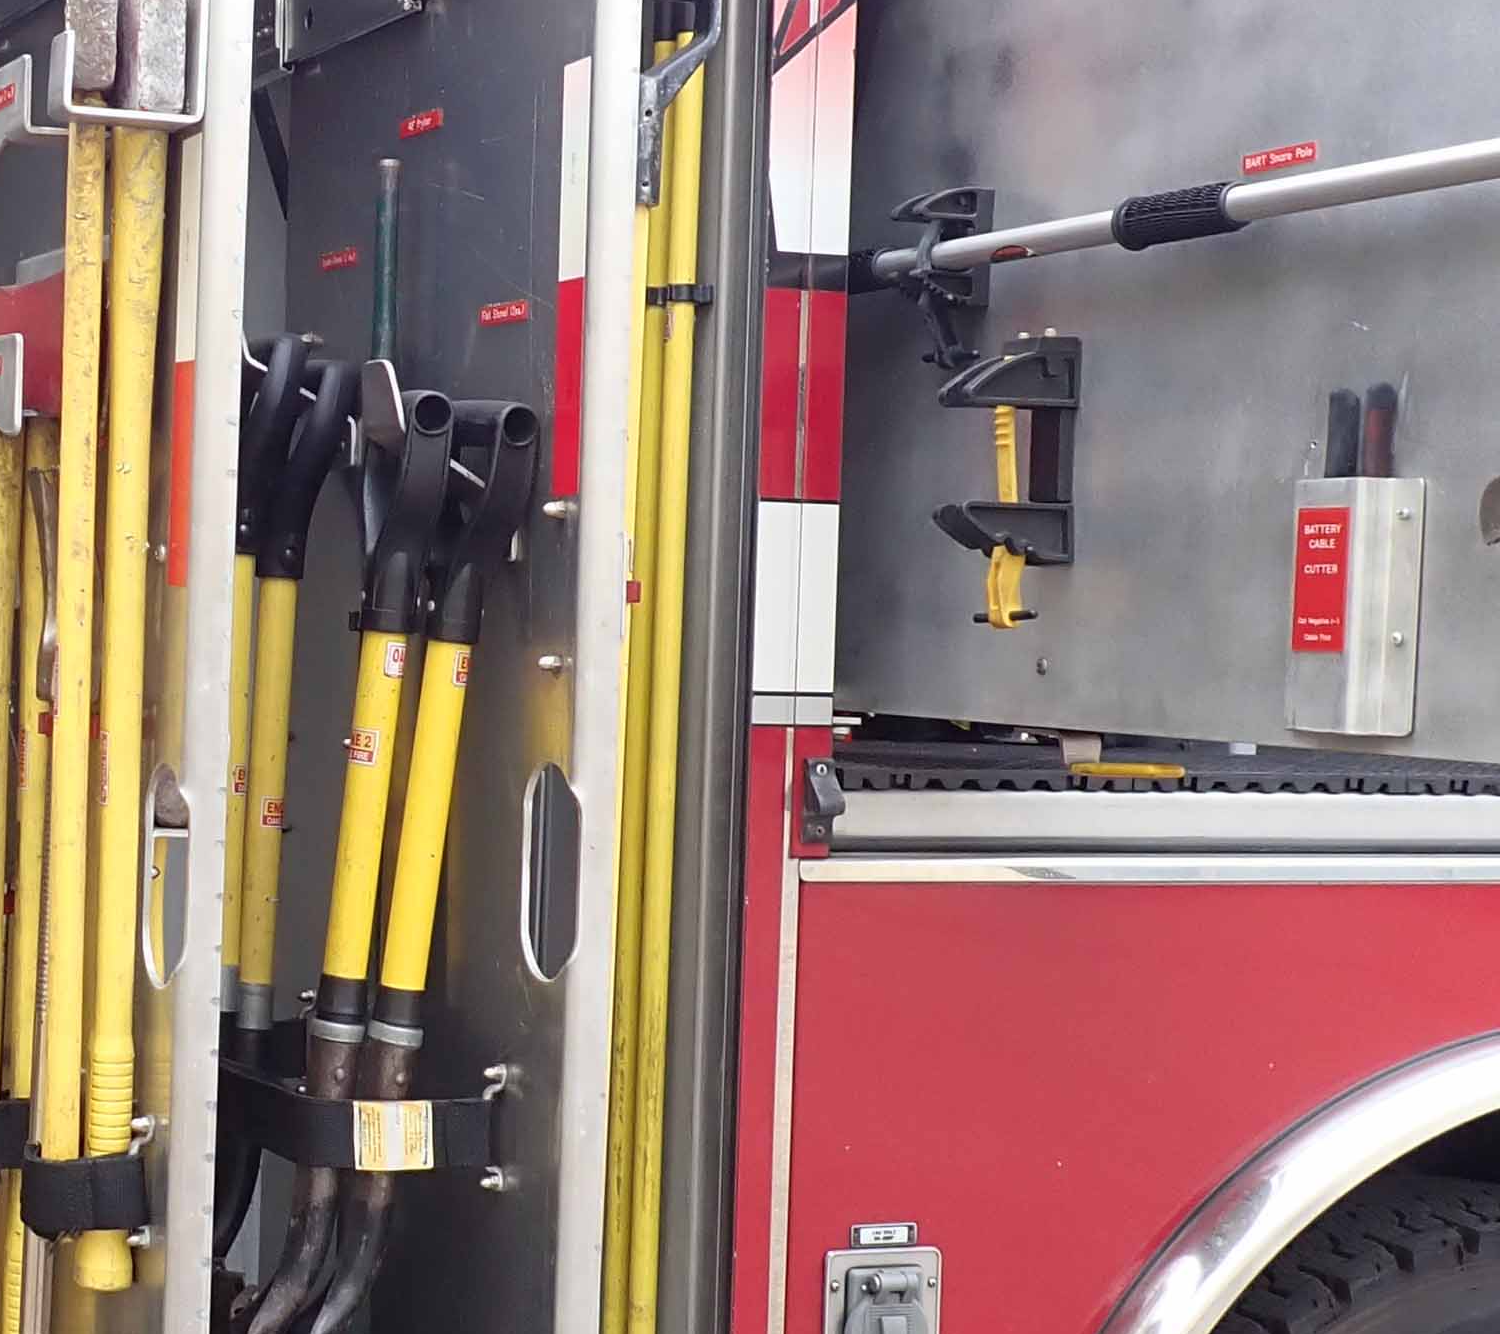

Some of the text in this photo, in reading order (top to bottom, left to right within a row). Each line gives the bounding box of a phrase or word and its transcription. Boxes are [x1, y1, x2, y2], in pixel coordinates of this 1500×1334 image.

[1245, 154, 1268, 170] BART
[1294, 146, 1314, 159] Pole
[1303, 524, 1342, 536] BATTERY
[1308, 538, 1336, 549] CABLE
[1303, 563, 1339, 575] CUTTER
